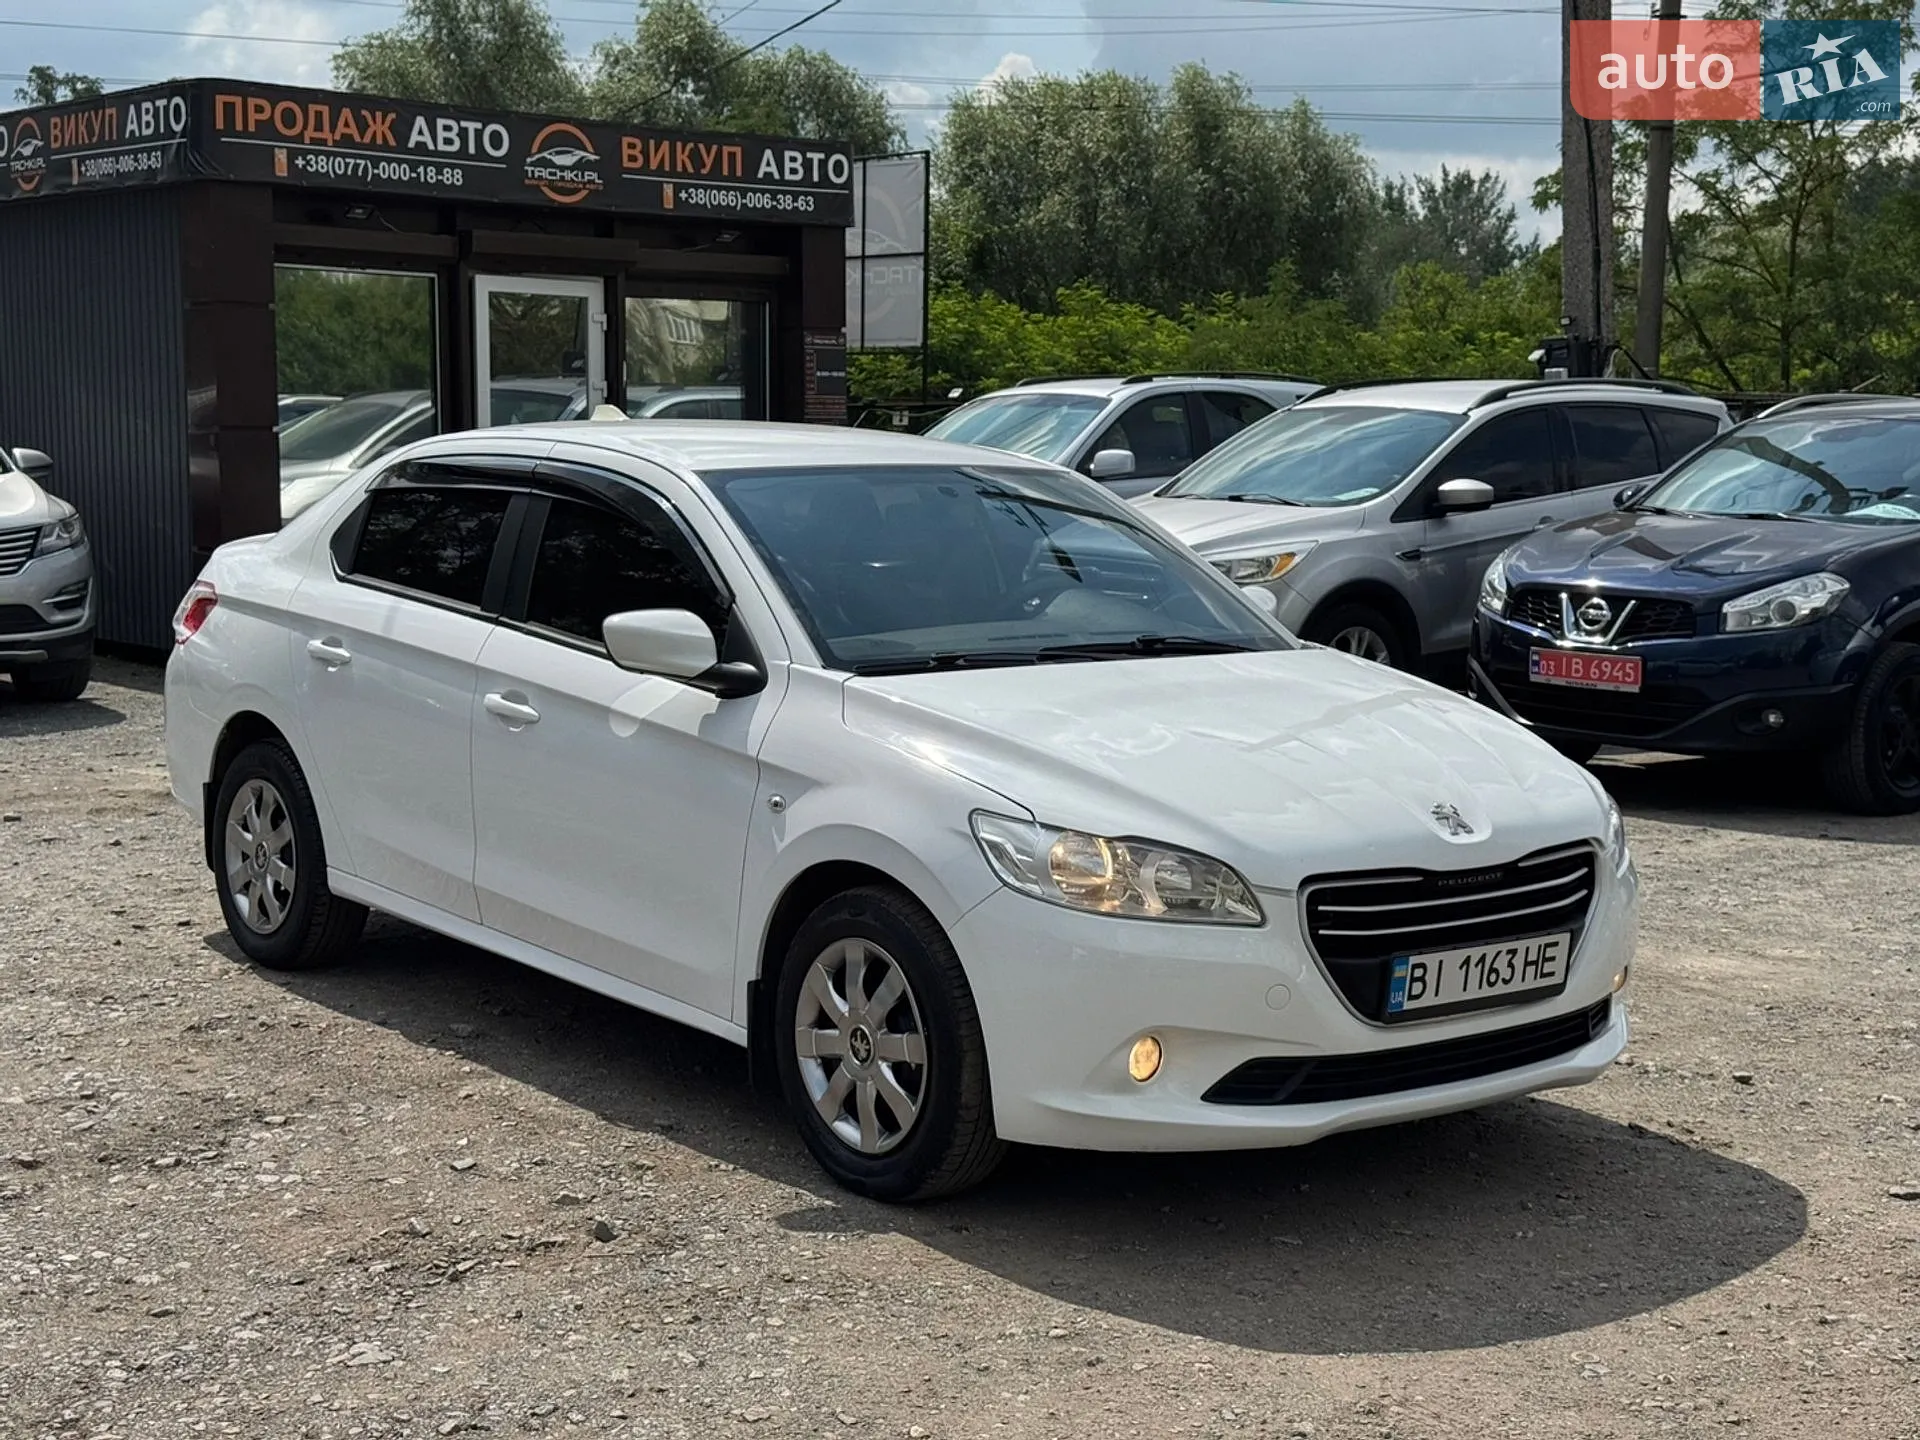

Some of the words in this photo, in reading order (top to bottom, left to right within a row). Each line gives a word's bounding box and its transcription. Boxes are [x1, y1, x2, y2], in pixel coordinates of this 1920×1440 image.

[50, 106, 117, 149] ВИКУП
[125, 95, 187, 139] АВТО
[215, 94, 397, 147] ПРОДАЖ
[407, 115, 510, 157] АВТО
[80, 151, 162, 180] +38(066)-006-38-63
[294, 154, 463, 186] +38(077)-000-18-88
[524, 165, 604, 184] TACHKI.PL
[621, 136, 743, 177] ВИКУП
[757, 148, 849, 184] АВТО
[678, 189, 815, 212] +38(066)-006-38-63
[1540, 660, 1555, 675] 03
[1590, 660, 1634, 682] 6945
[1438, 871, 1504, 887] PEUGEOT
[1406, 959, 1443, 1001] BI
[1458, 948, 1518, 992] 1163
[1521, 941, 1559, 983] HE
